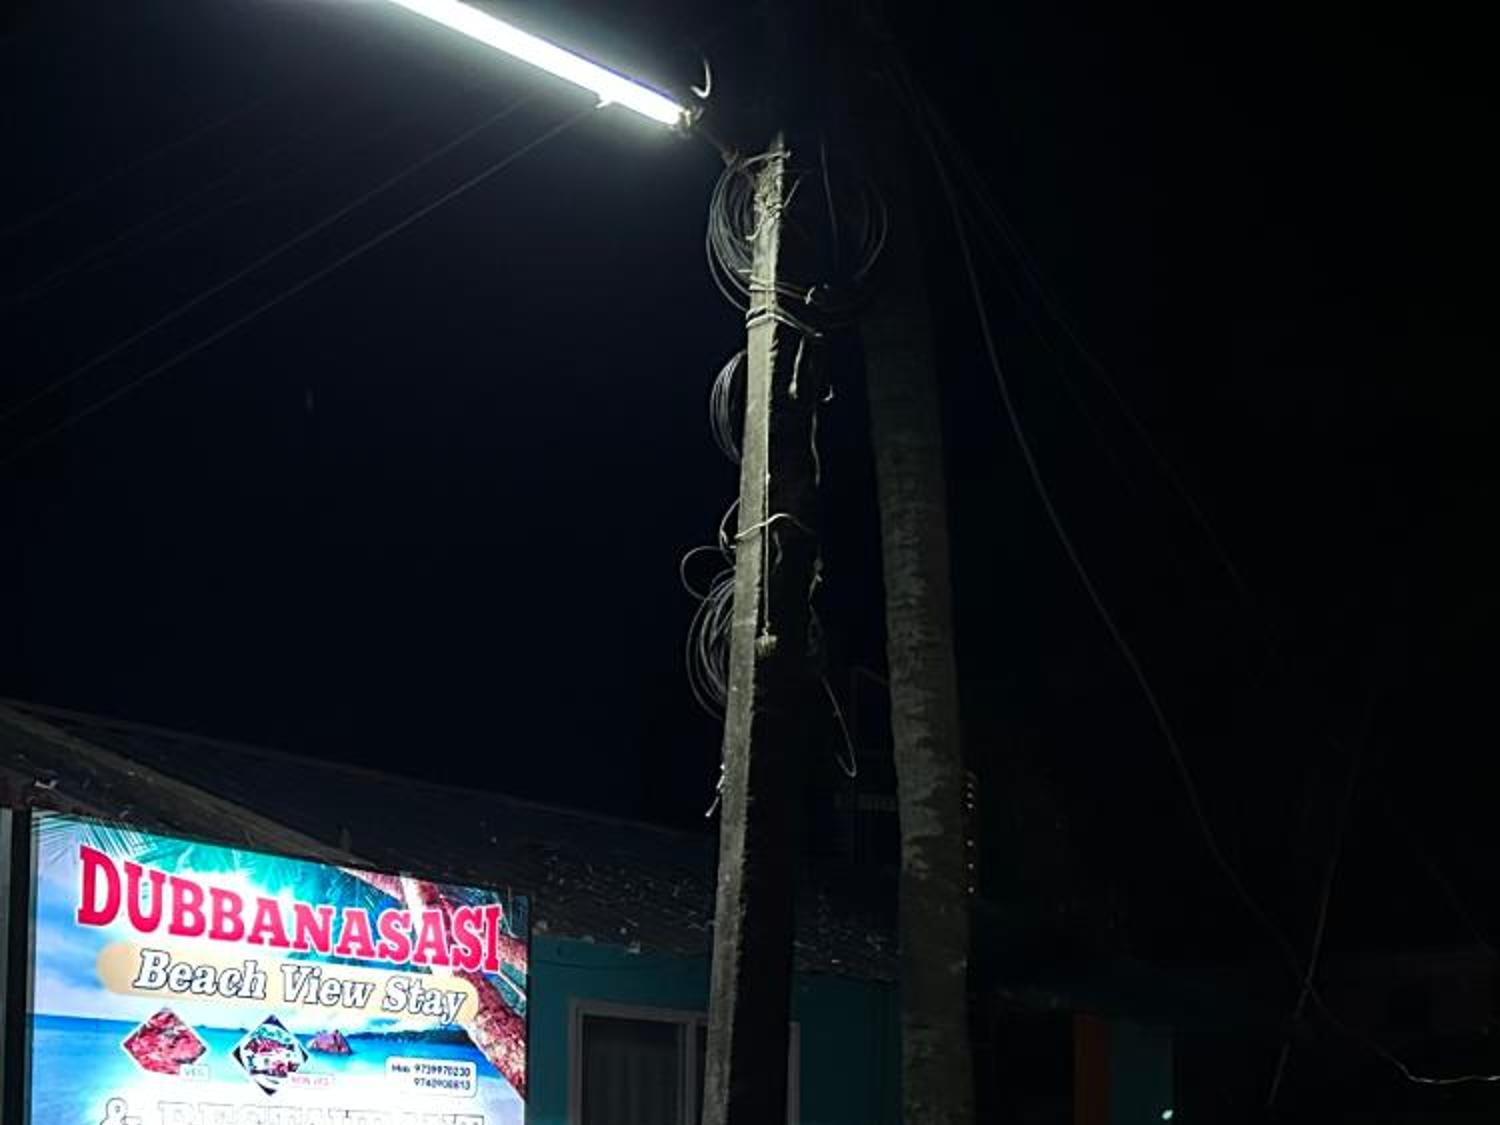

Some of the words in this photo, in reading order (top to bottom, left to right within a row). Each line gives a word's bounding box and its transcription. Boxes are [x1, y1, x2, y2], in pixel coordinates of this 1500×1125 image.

[76, 845, 502, 973] DUBBANASASI
[132, 947, 267, 1001] Beach
[280, 963, 375, 1009] View
[381, 975, 468, 1026] Stay
